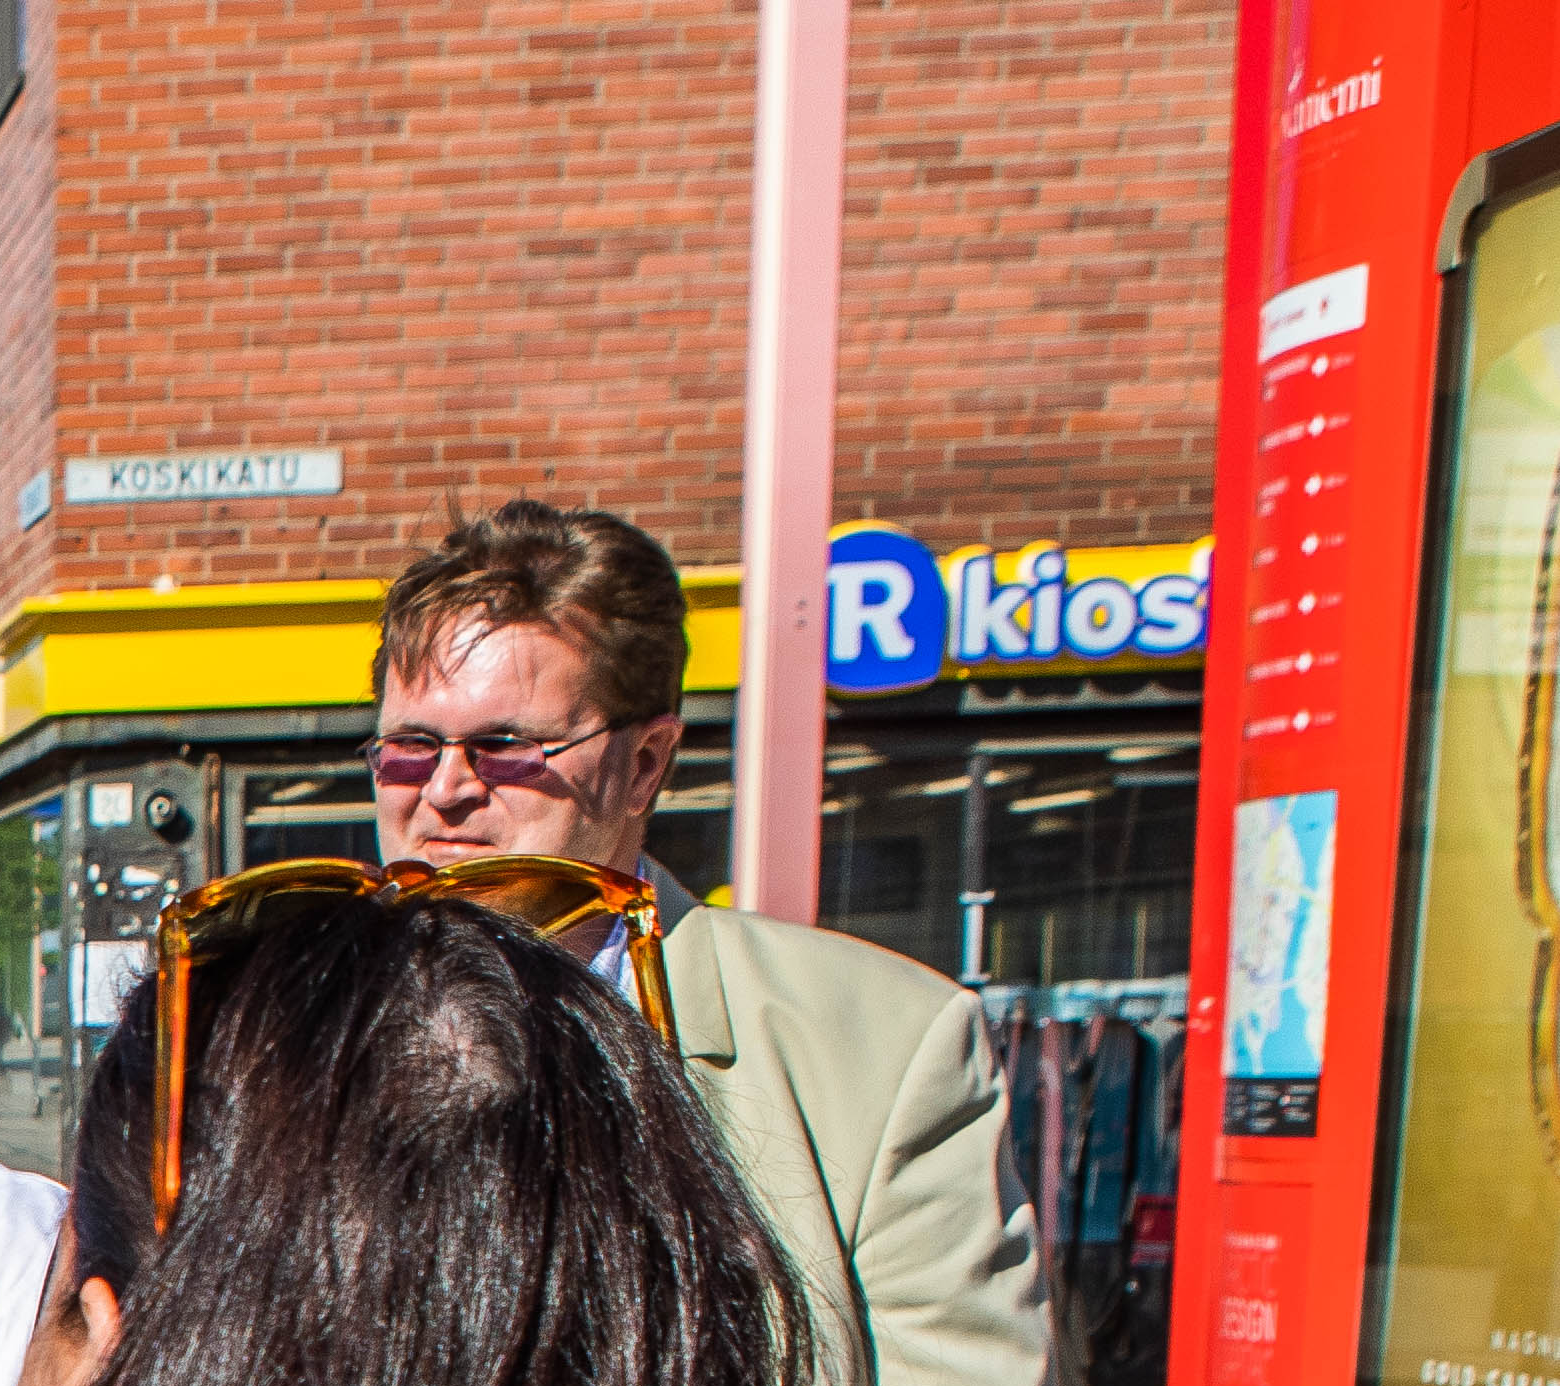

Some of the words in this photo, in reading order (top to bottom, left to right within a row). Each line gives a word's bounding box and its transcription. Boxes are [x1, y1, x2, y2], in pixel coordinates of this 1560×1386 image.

[110, 456, 301, 492] KOSKIKATU
[828, 558, 916, 664] R
[962, 551, 1209, 660] kios
